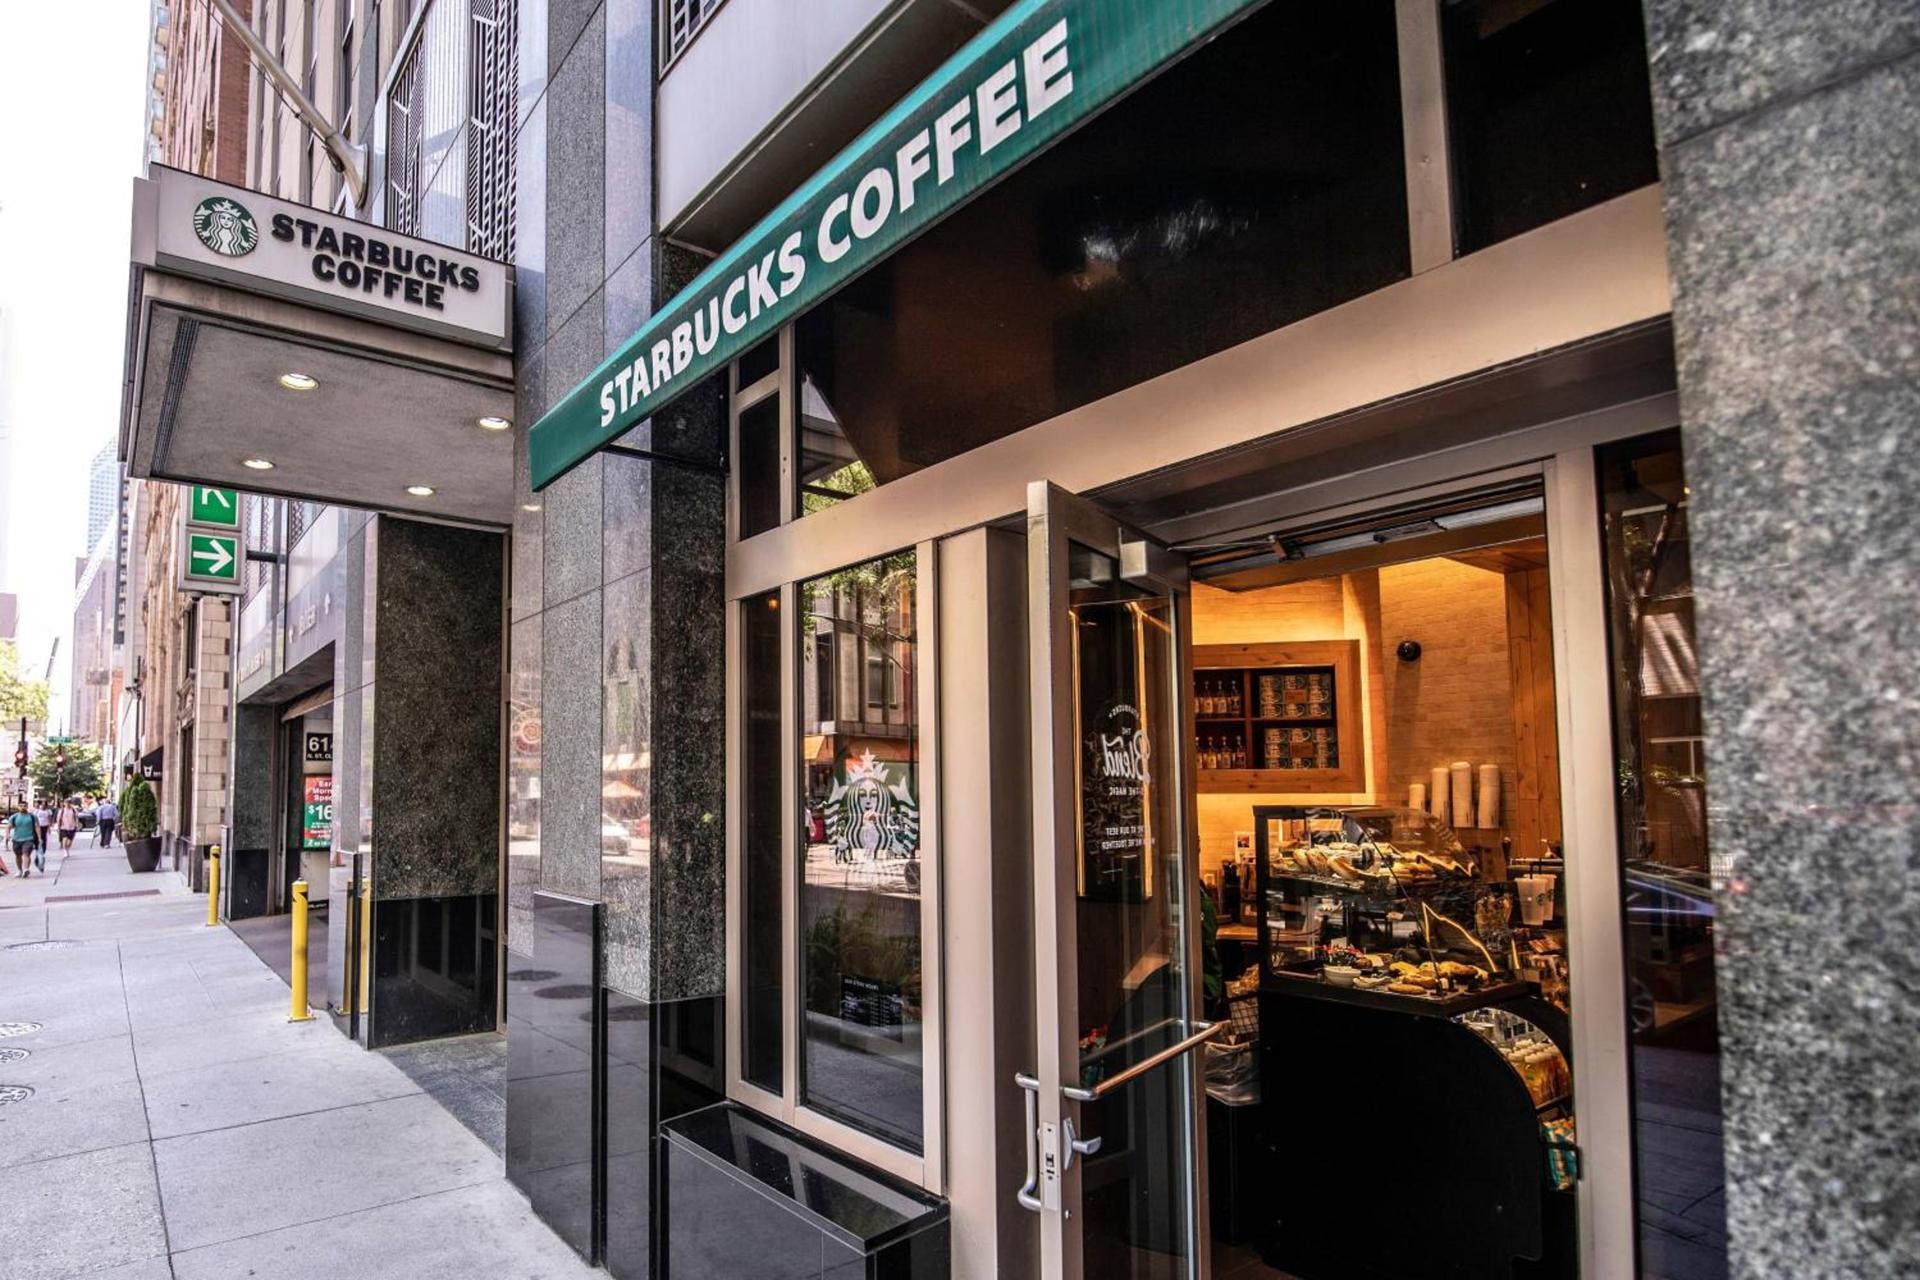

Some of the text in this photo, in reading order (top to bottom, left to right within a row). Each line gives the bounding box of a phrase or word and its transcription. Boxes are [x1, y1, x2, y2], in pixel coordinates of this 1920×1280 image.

[271, 212, 480, 292] STARBUCKS
[600, 17, 1074, 428] STARBUCKS COFFEE
[312, 254, 445, 311] COFFEE
[308, 736, 333, 752] 61
